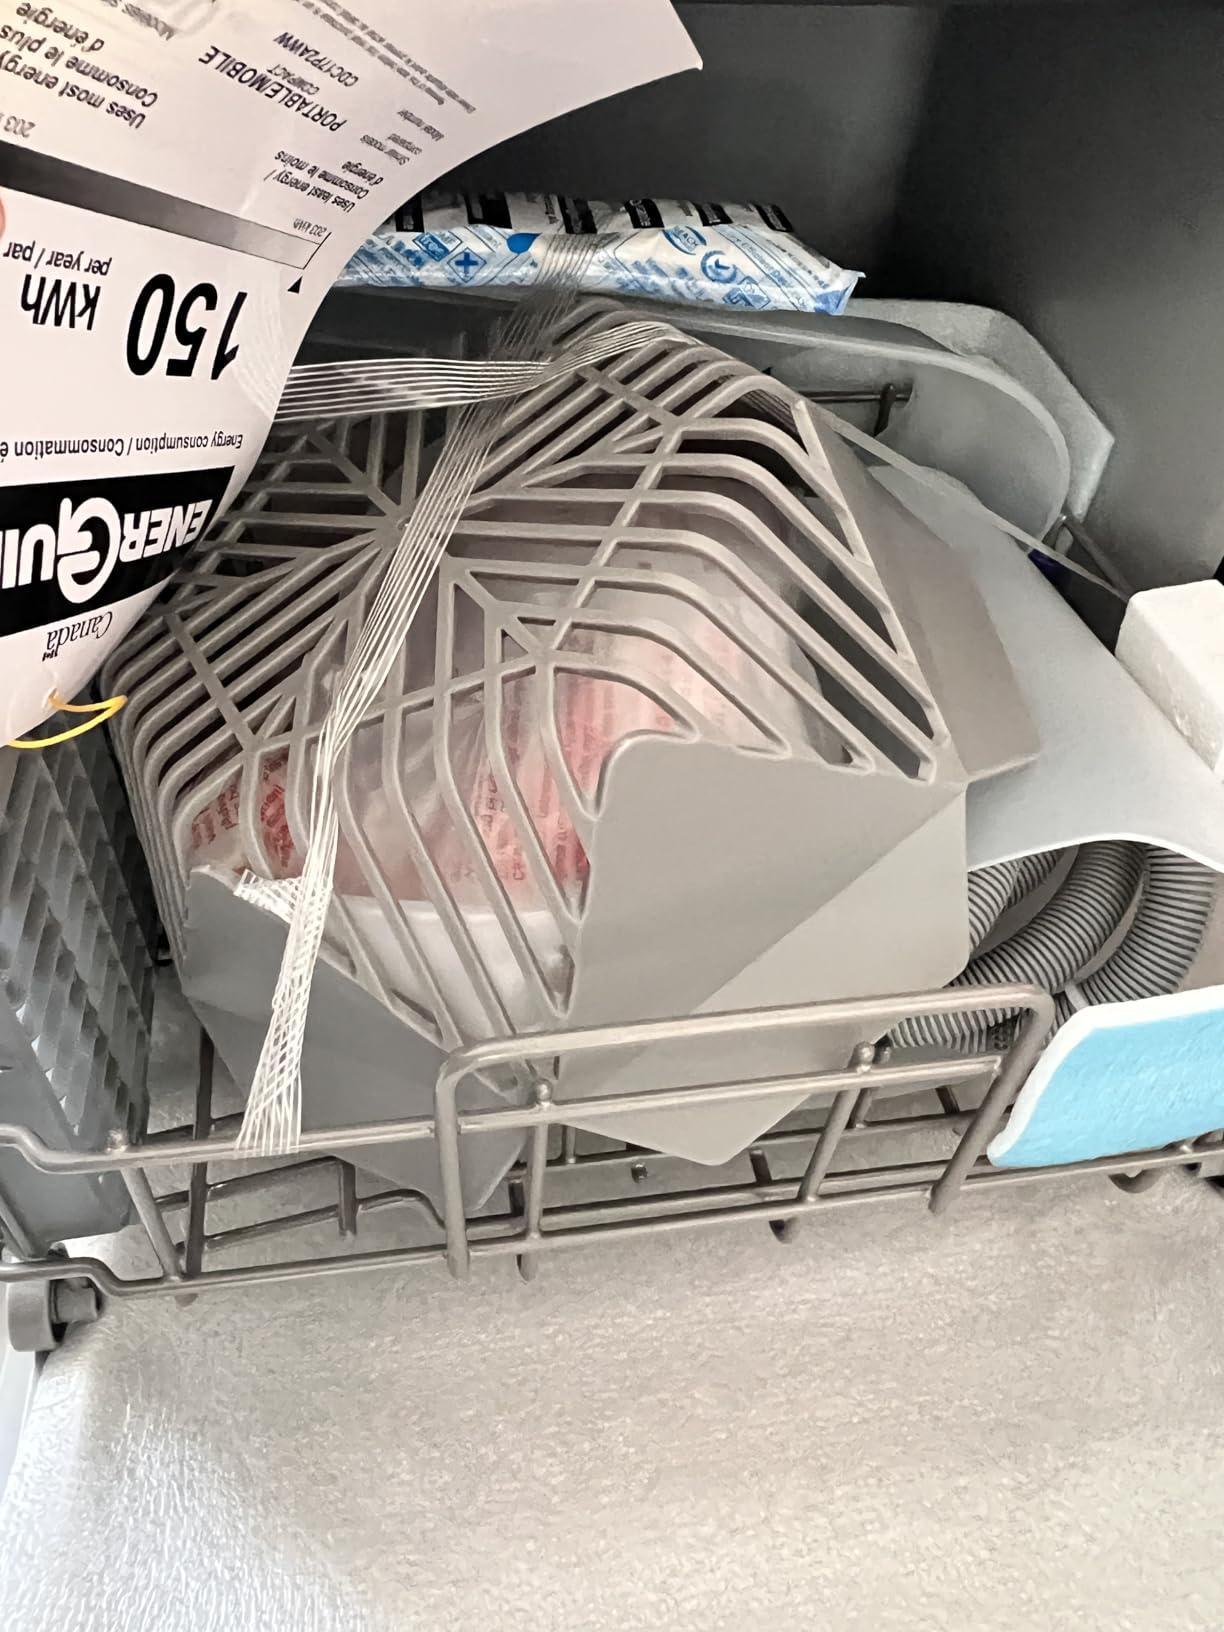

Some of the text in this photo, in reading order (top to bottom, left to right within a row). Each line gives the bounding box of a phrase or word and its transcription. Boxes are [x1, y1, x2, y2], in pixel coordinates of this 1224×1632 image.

[16, 2, 105, 52] d'énergie
[0, 24, 158, 107] Consomme le plus
[58, 81, 105, 108] most
[198, 45, 348, 132] PORTABLE/MOBILE
[3, 115, 36, 138] 203
[106, 101, 146, 129] Uses
[264, 169, 355, 213] Uses least energy /
[274, 150, 369, 200] Consomme le moins
[2, 240, 112, 276] per year / par
[21, 274, 101, 331] kWh
[127, 273, 248, 380] 150
[14, 438, 124, 459] Consommation
[127, 437, 133, 456] /
[135, 433, 209, 454] consumption
[211, 431, 243, 449] Energy
[0, 497, 213, 603] ENERGUI
[46, 611, 113, 652] Canada
